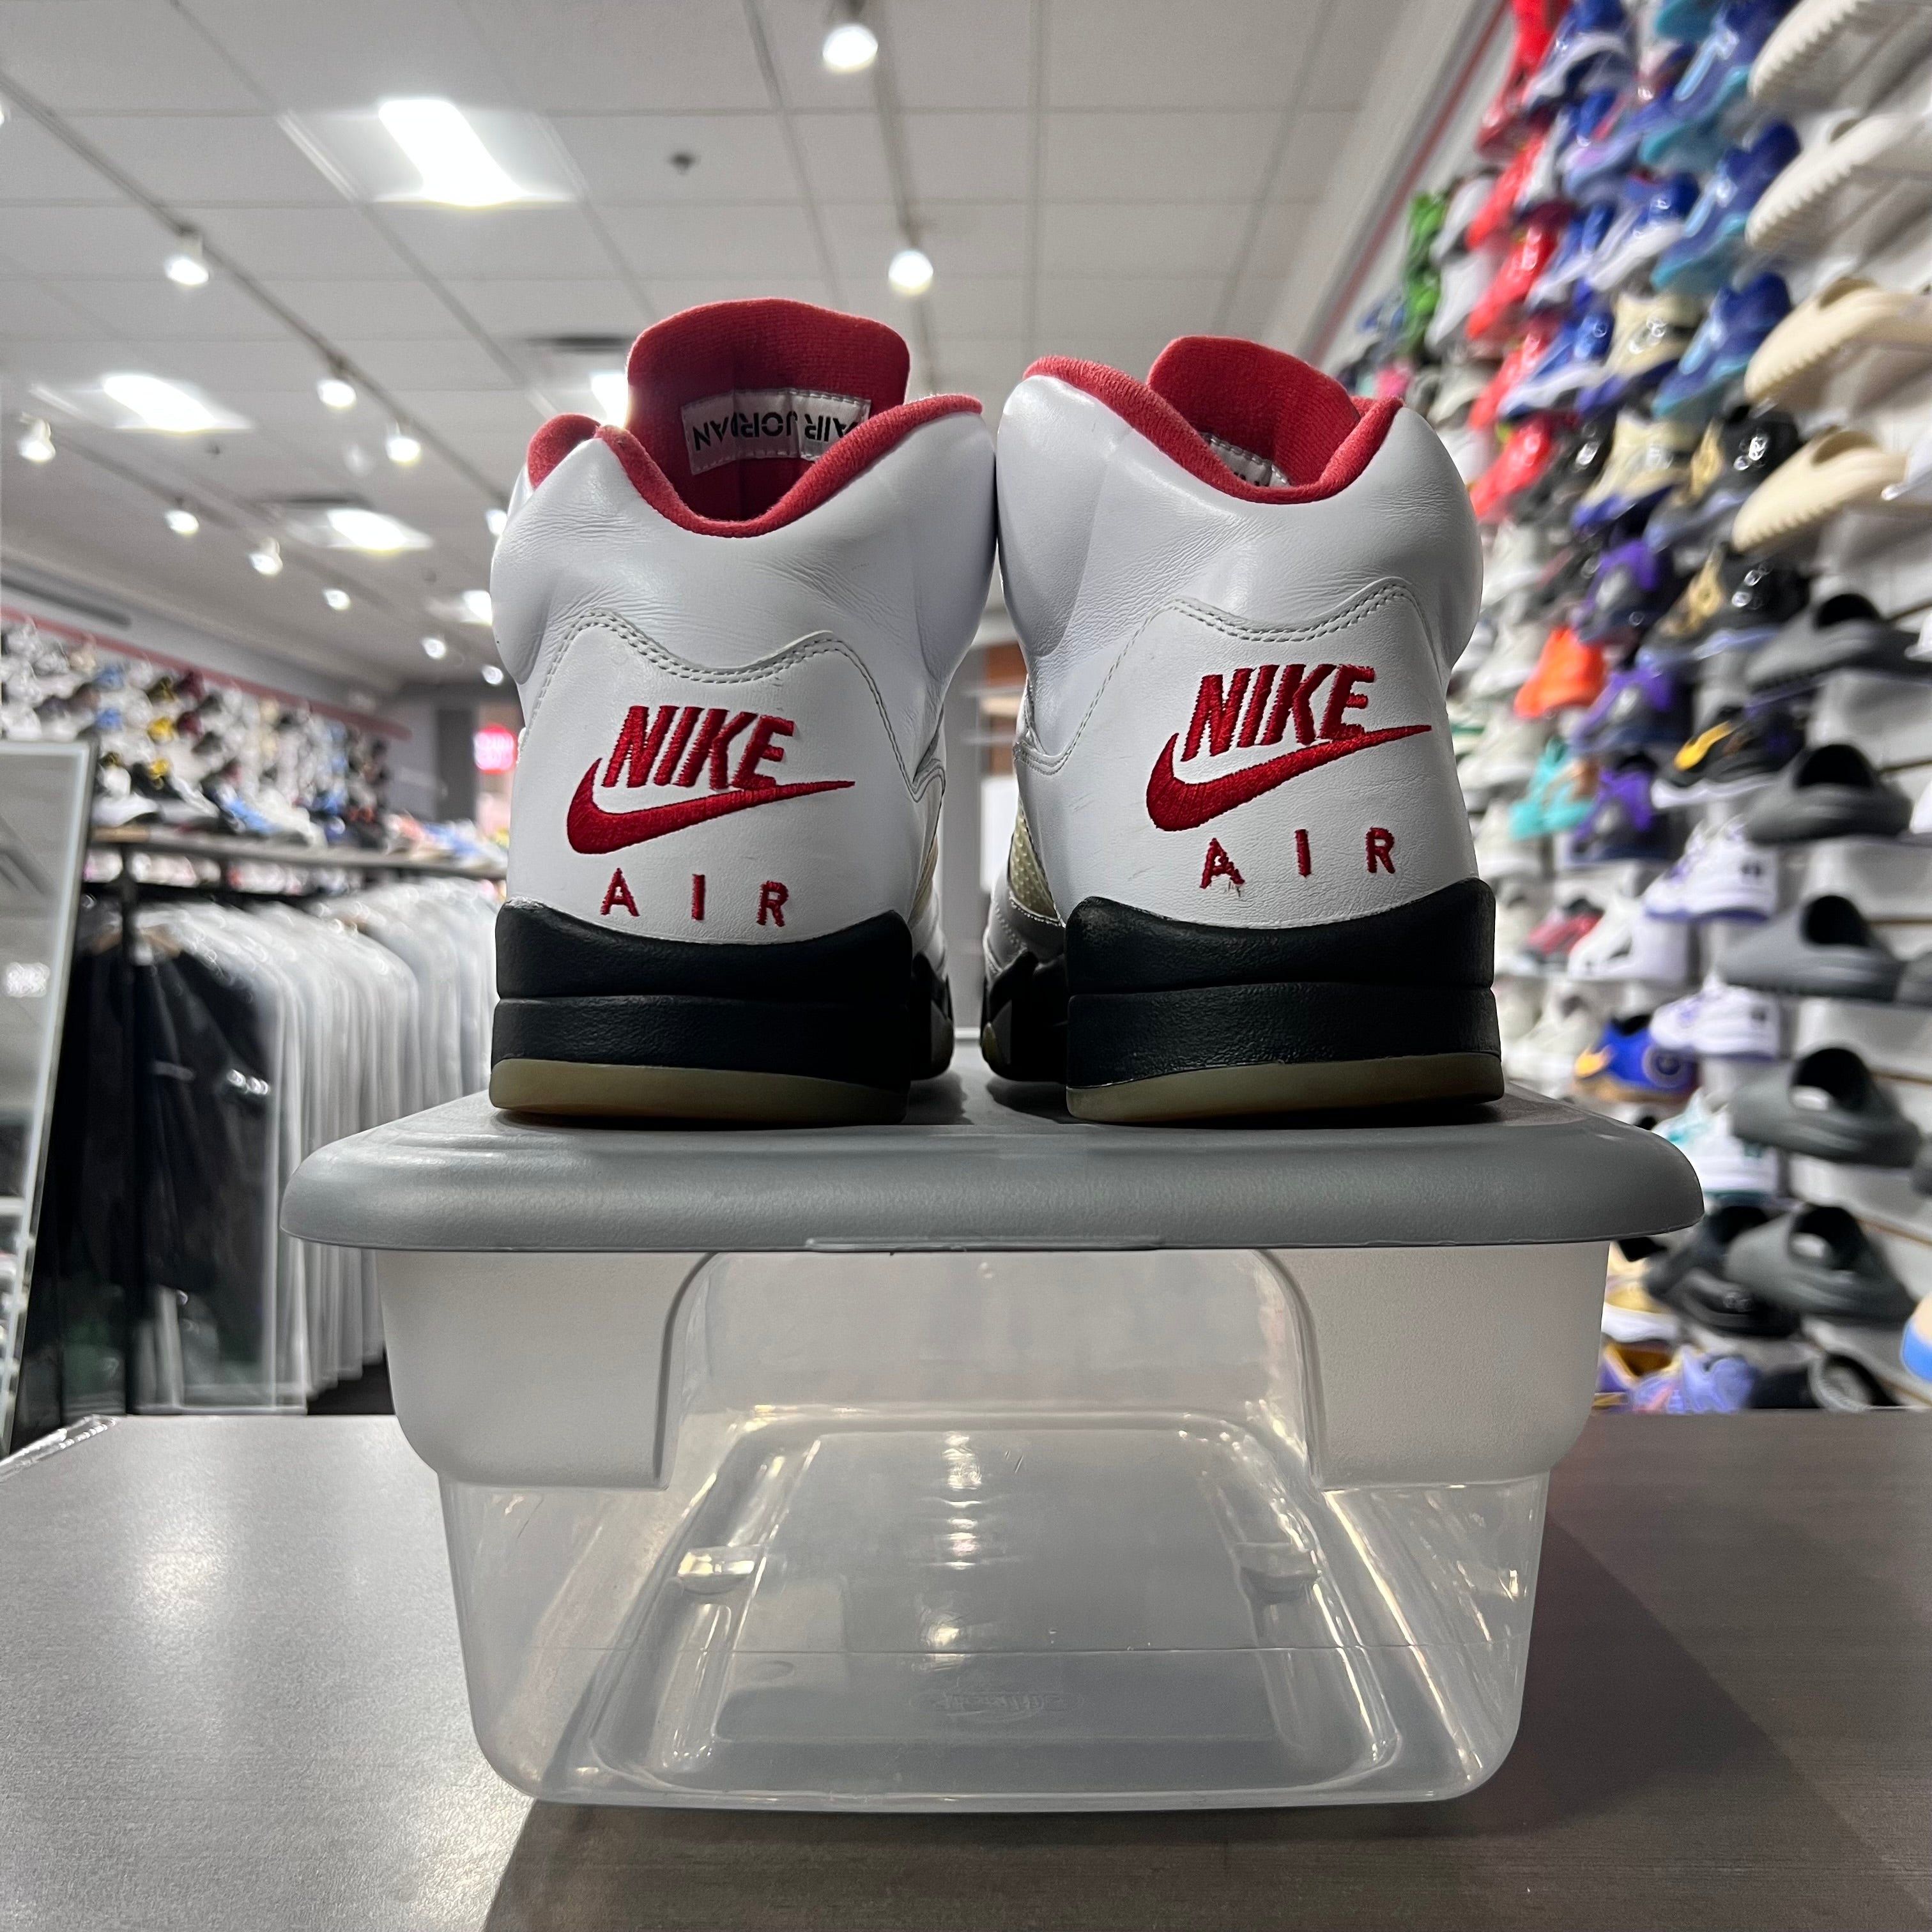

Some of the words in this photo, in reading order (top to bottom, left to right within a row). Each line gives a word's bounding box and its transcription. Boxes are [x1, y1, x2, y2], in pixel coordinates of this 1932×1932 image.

[693, 411, 798, 451] JORDAN
[804, 413, 858, 442] AIR
[1180, 663, 1376, 762] NIKE
[601, 705, 795, 790] NIKE
[1199, 826, 1396, 889] AIR
[600, 868, 789, 927] AIR
